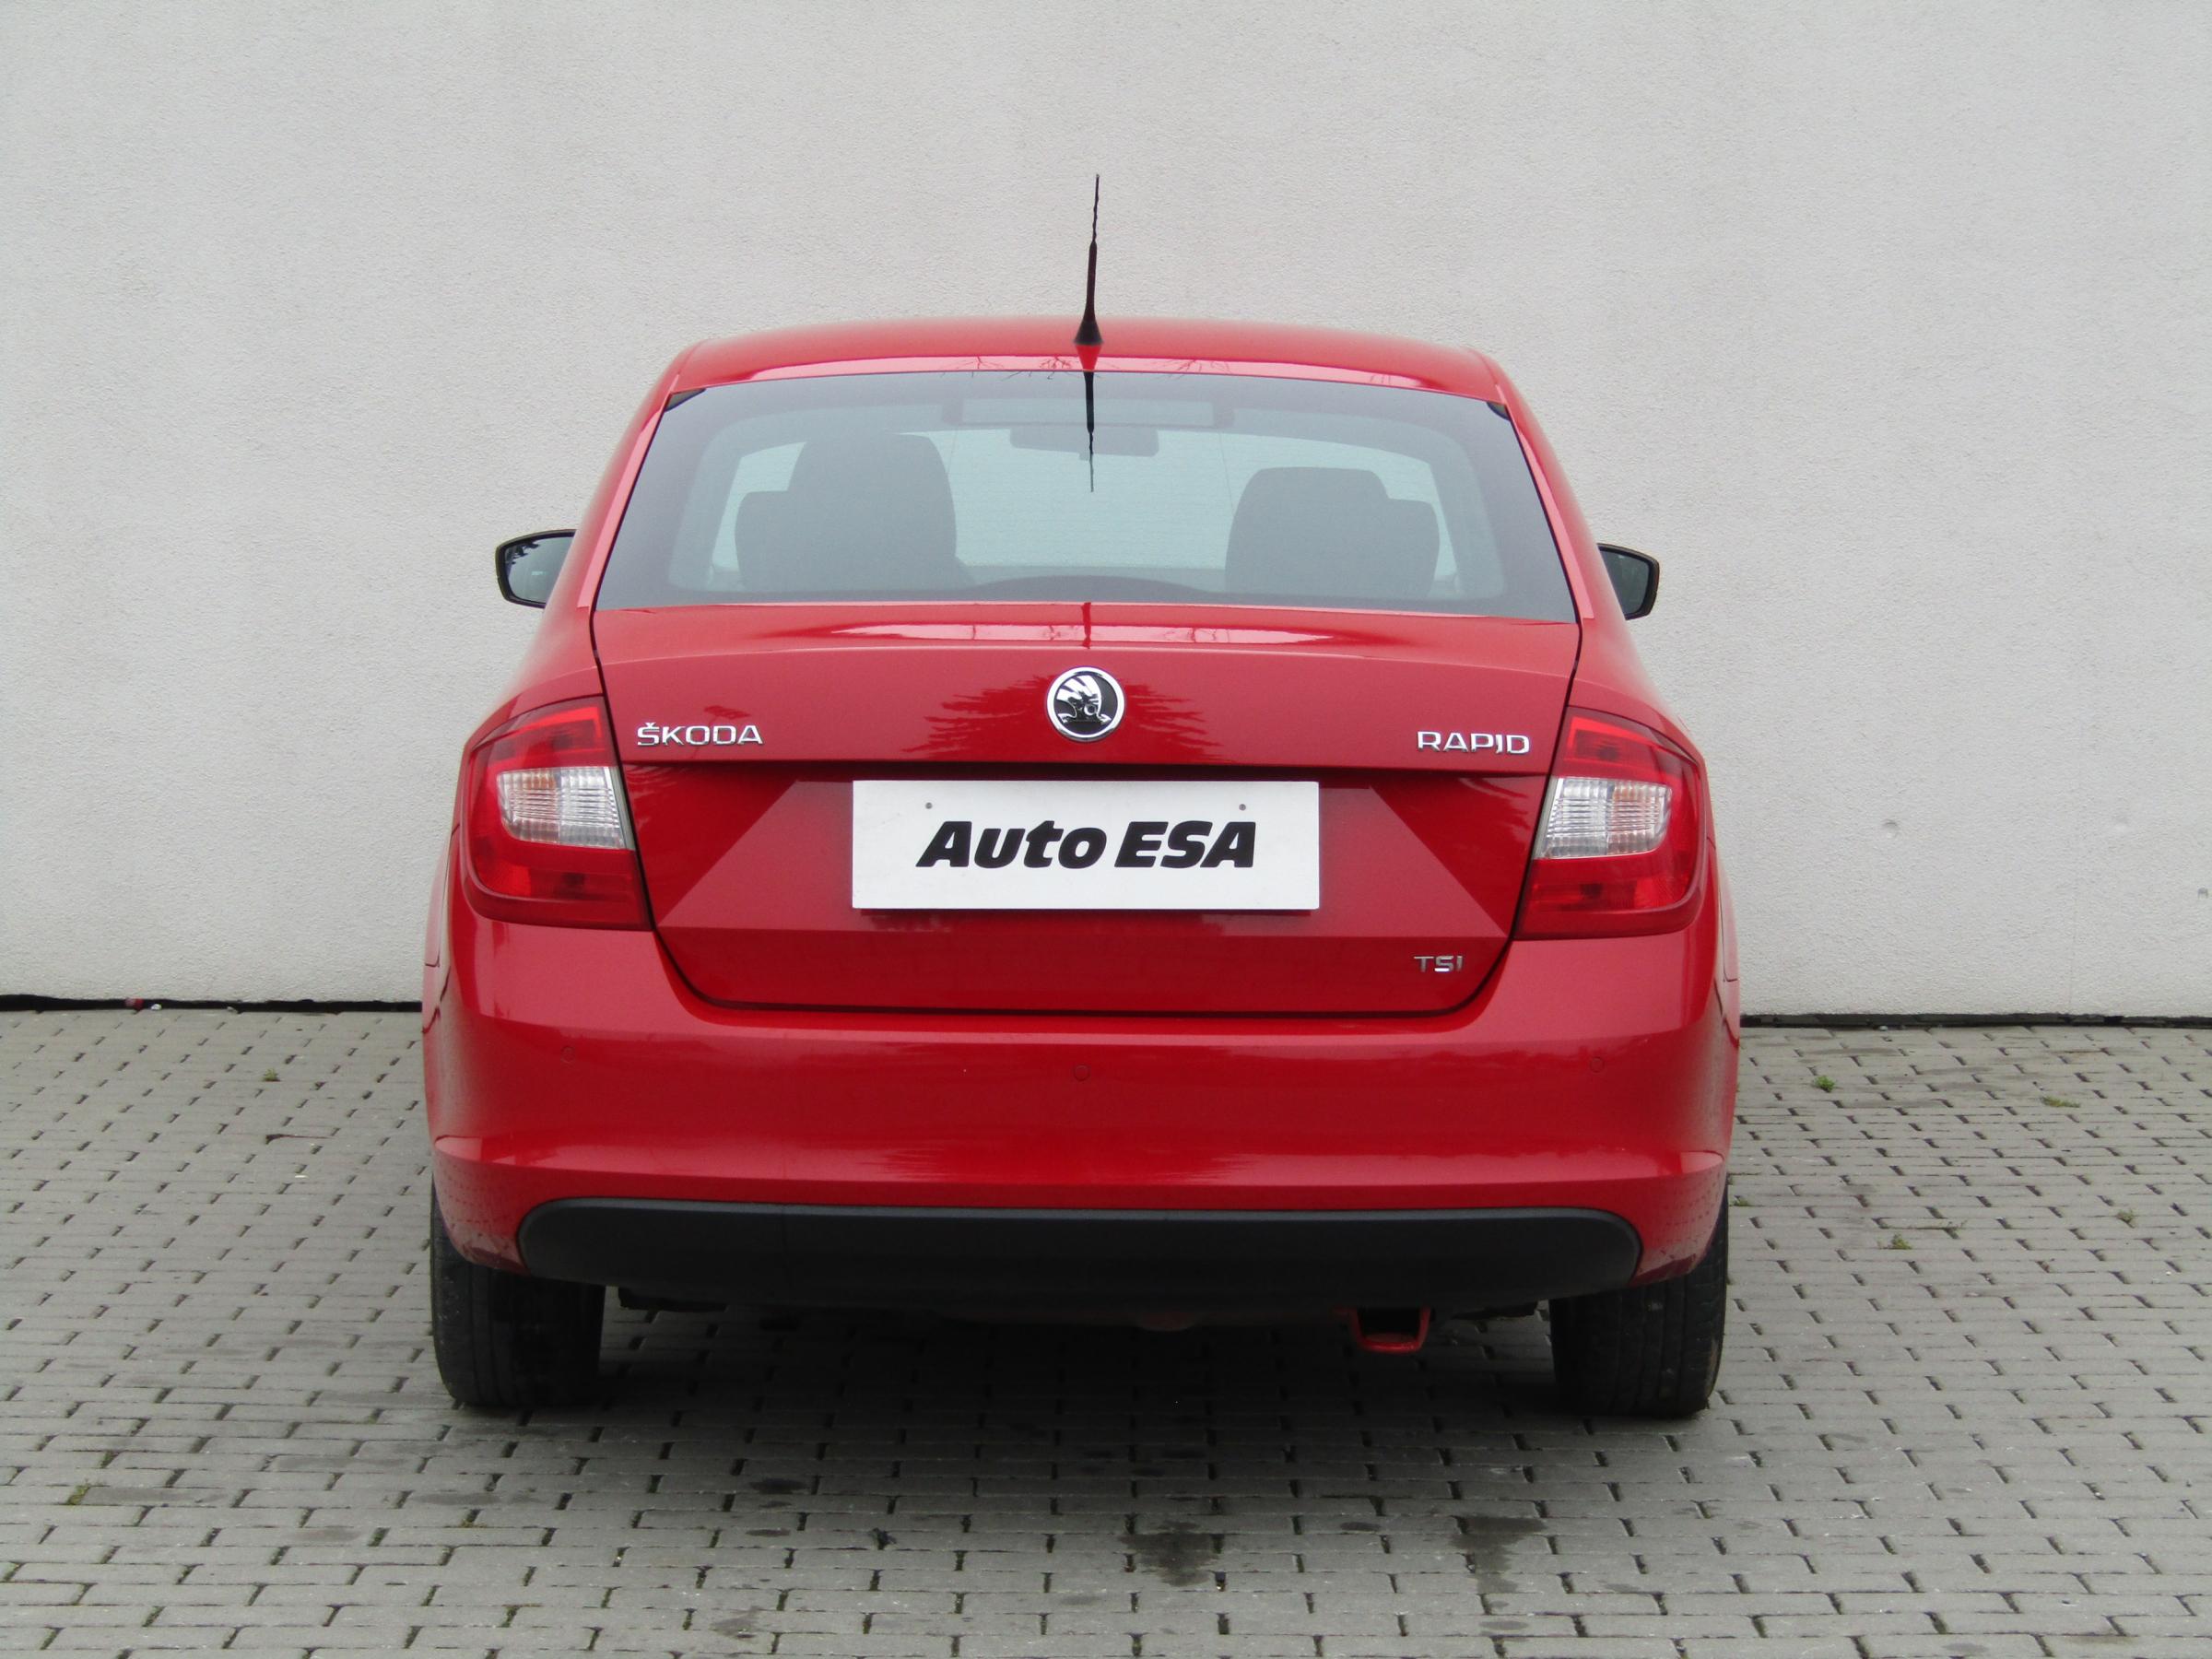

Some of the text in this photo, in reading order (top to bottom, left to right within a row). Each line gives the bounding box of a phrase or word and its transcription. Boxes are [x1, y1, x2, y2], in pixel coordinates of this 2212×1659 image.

[637, 722, 763, 746] ŠKODA
[1417, 731, 1530, 754] RAPID
[915, 820, 1256, 868] Auto ESA
[1413, 955, 1464, 972] TSI
